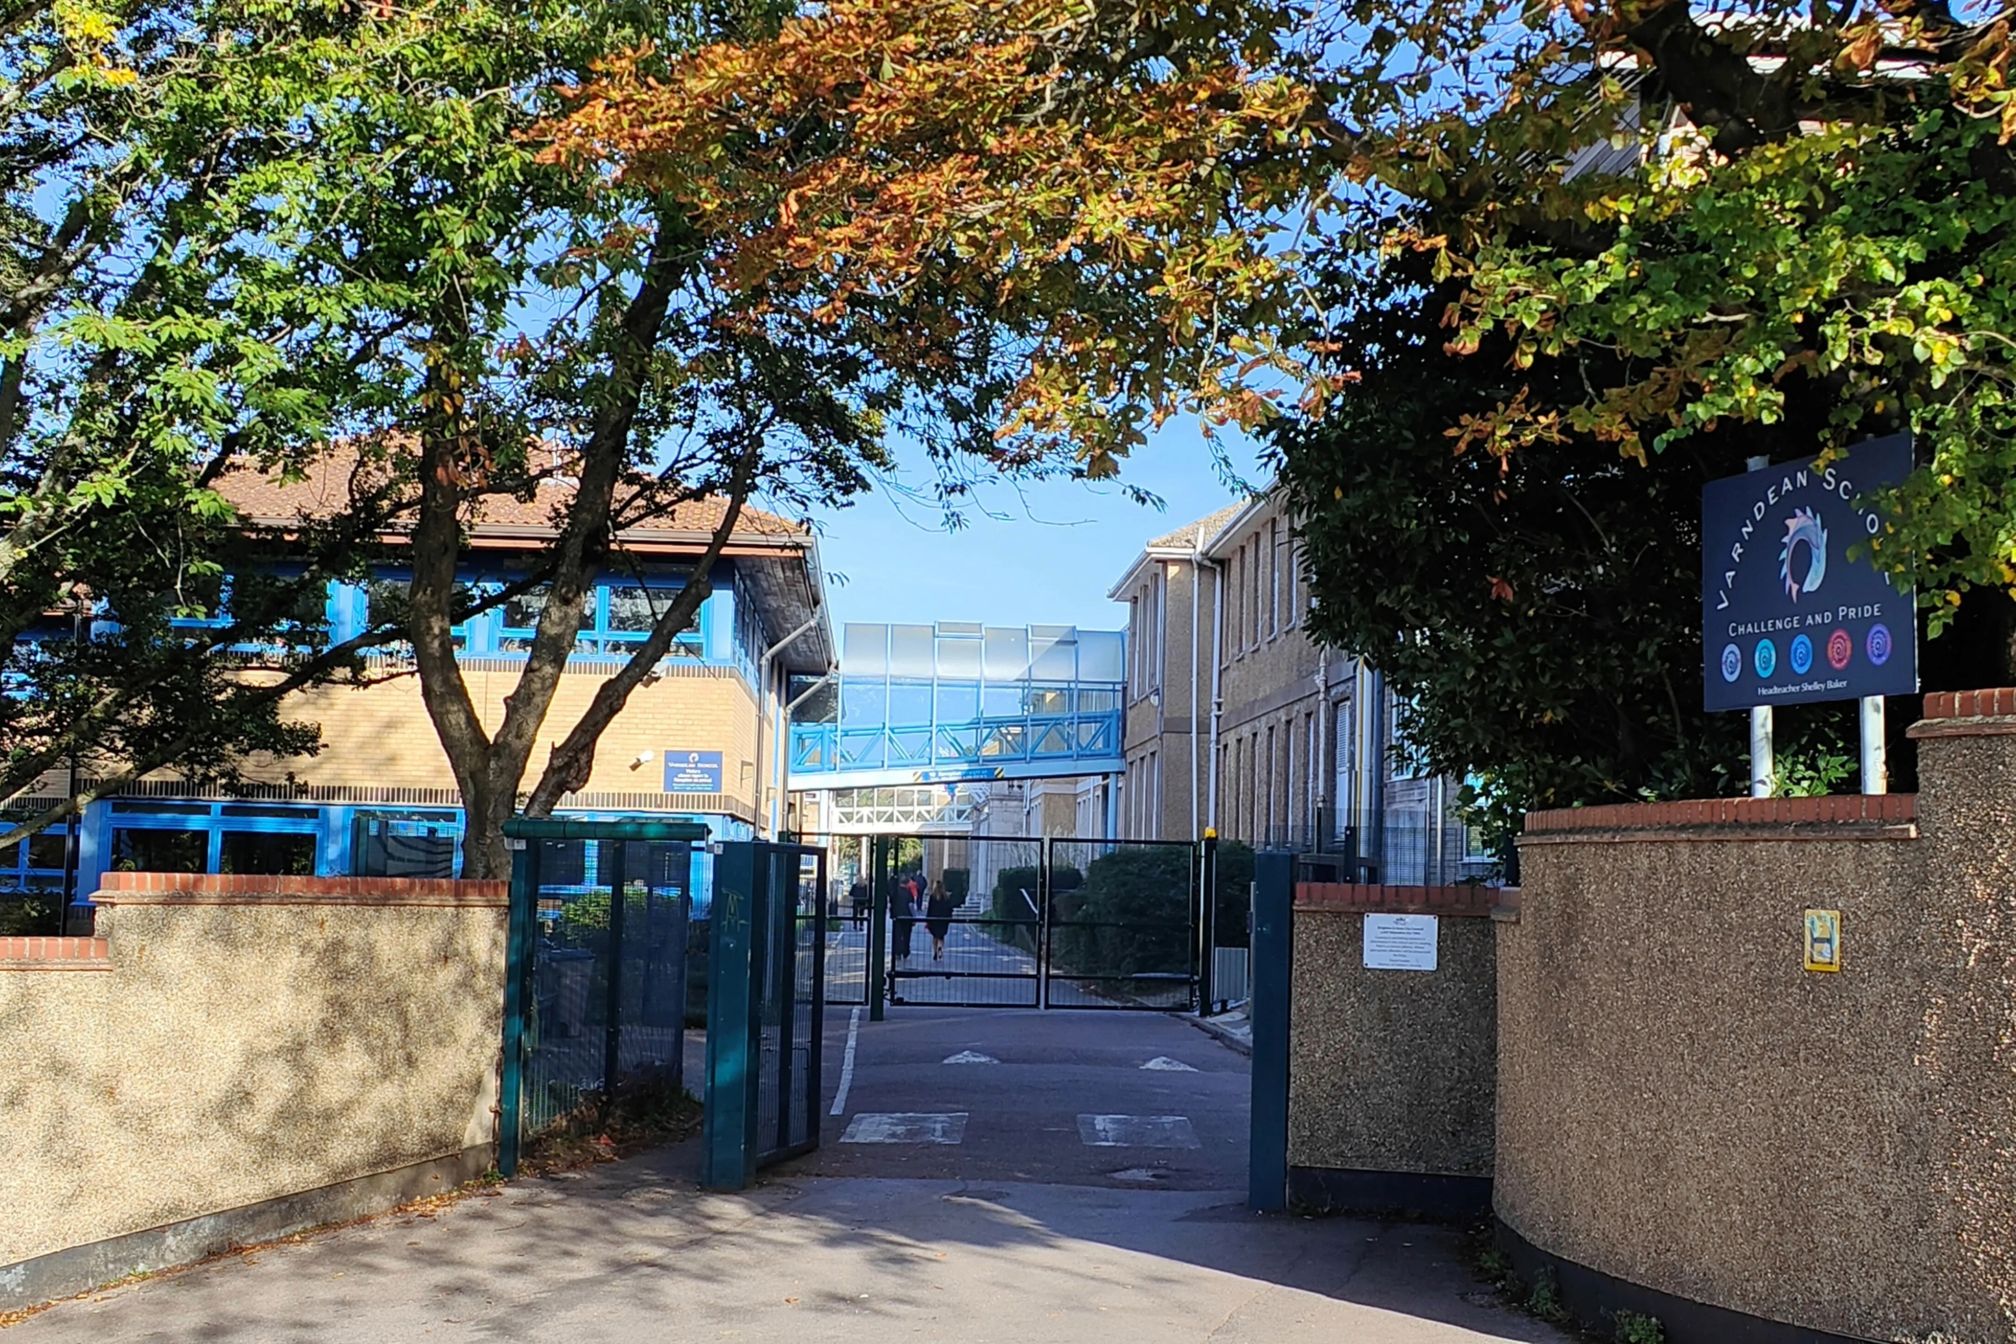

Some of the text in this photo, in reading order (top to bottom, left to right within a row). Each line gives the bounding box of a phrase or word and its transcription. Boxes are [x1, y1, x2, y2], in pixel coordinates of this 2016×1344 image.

[1716, 470, 1808, 610] VARNDEAN
[1728, 603, 1882, 637] CHALLENGE AND PRIDE
[1757, 678, 1848, 696] Headteacher Shelley Baker
